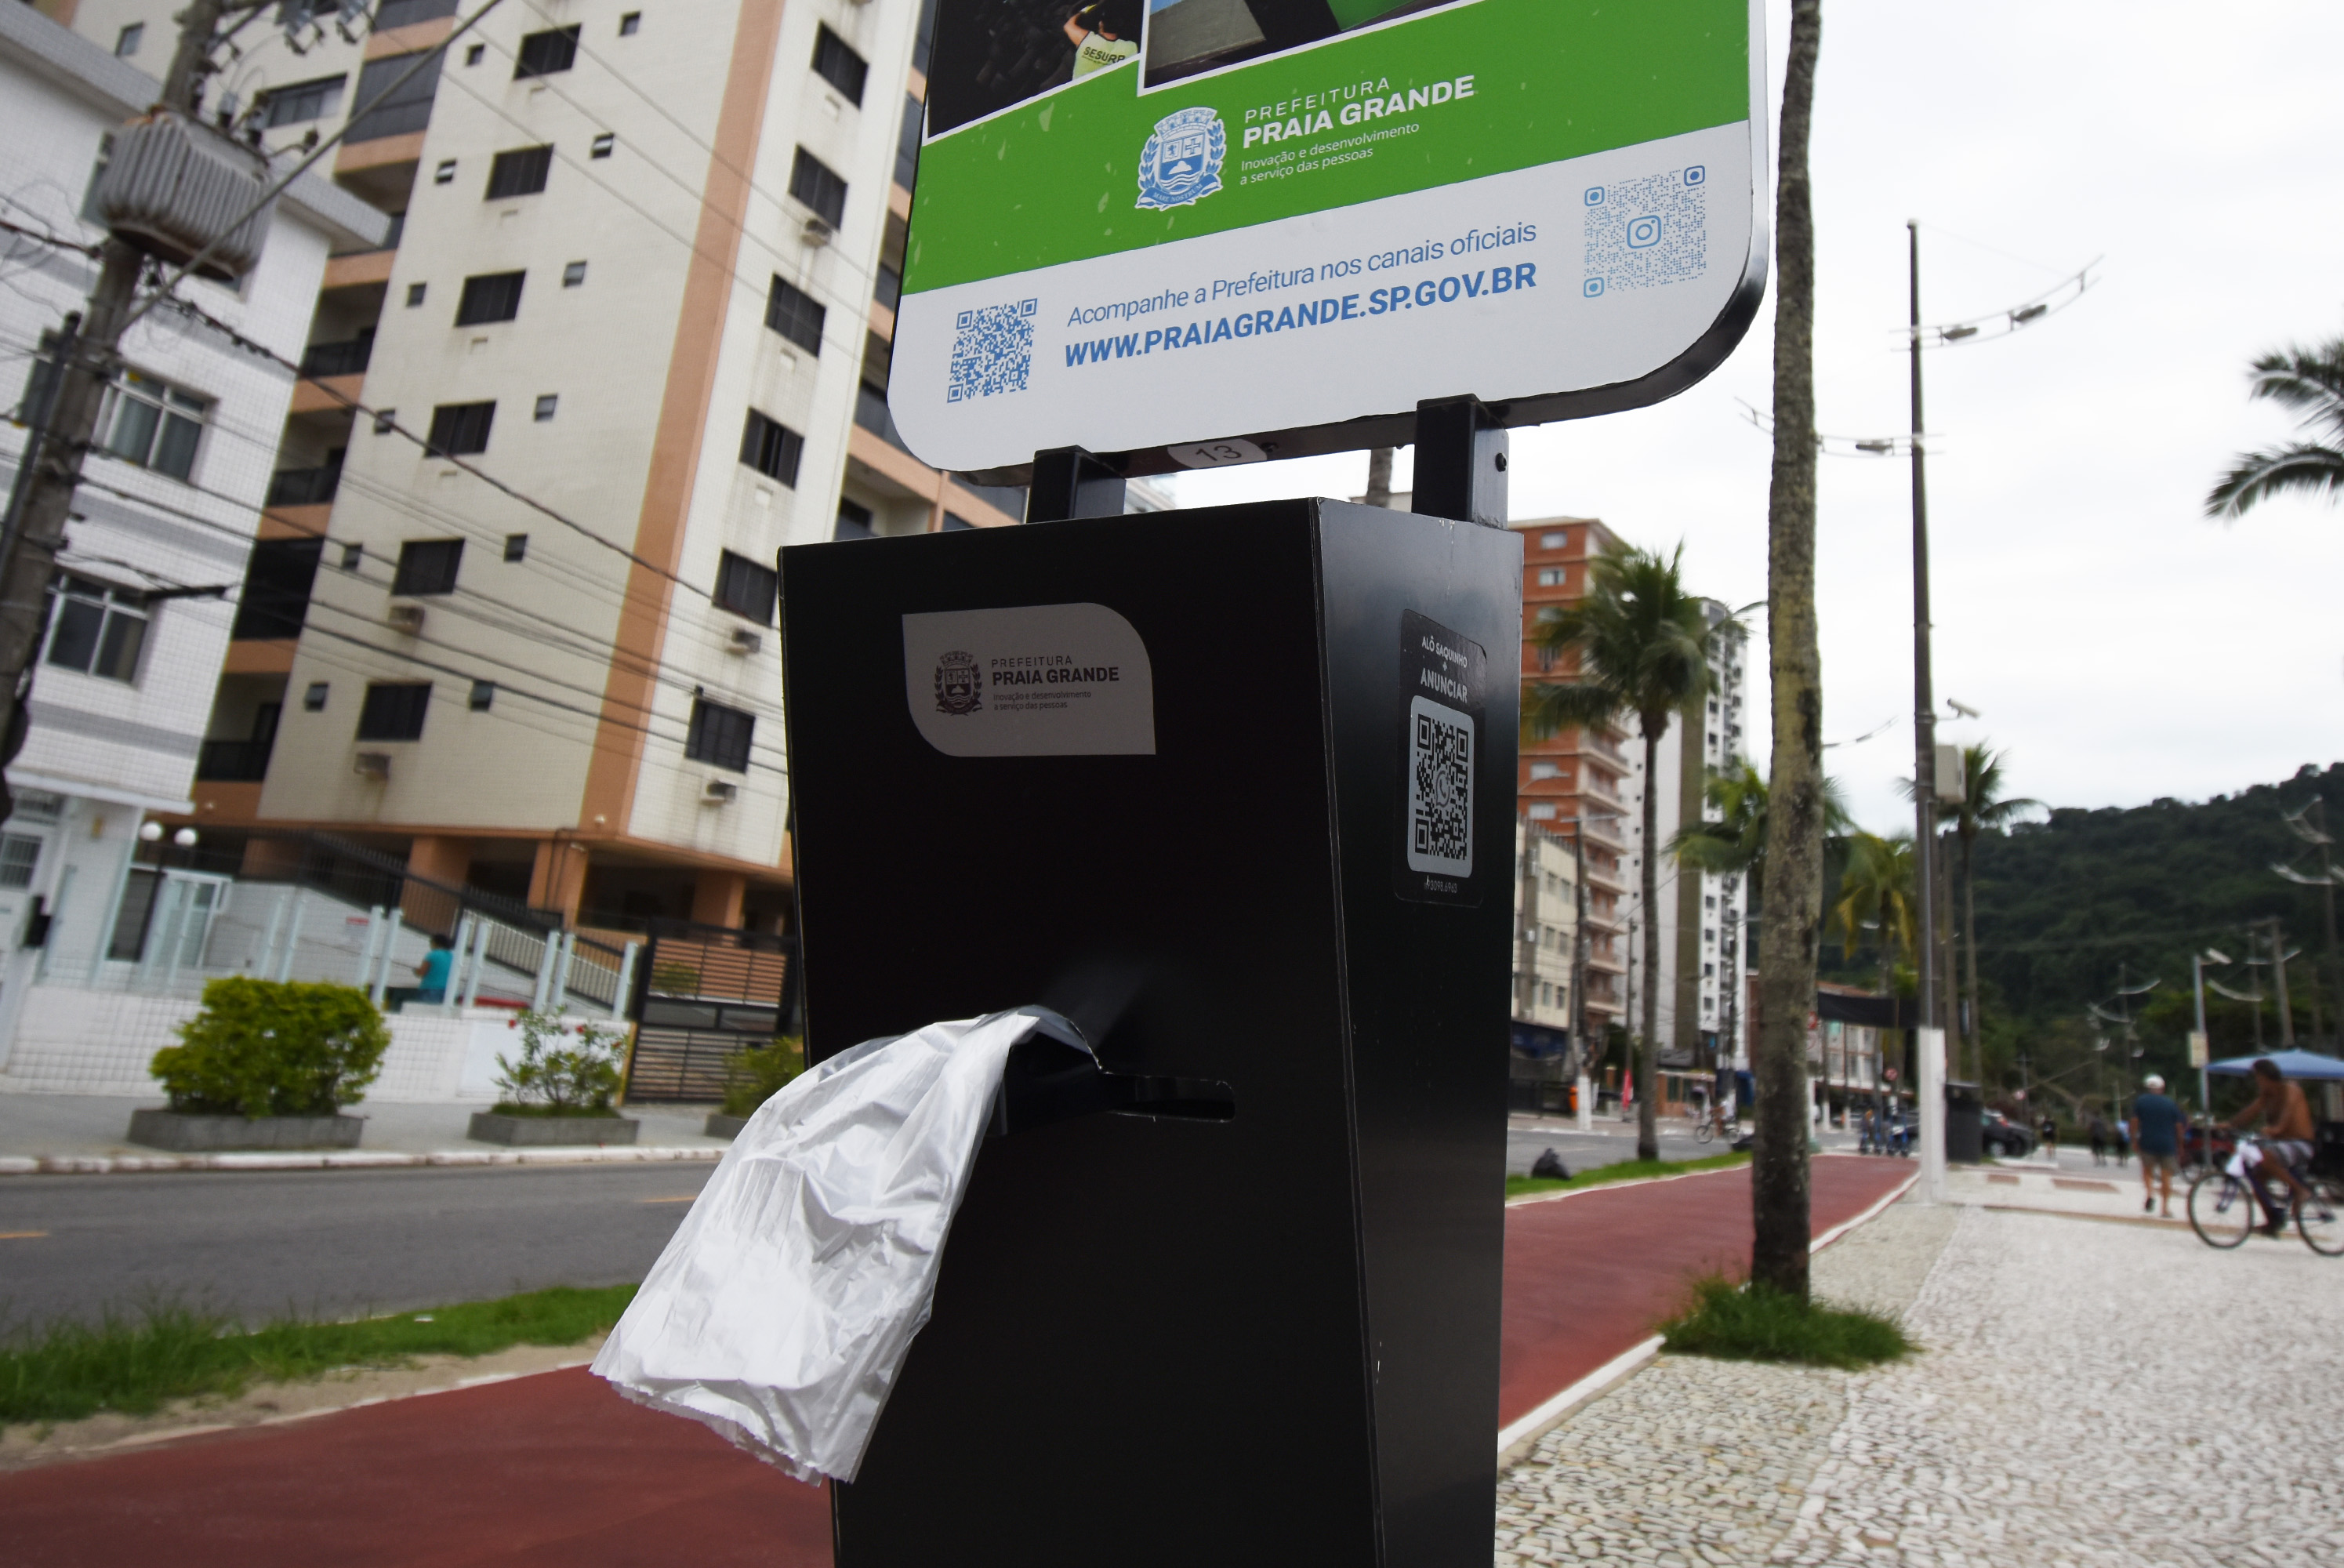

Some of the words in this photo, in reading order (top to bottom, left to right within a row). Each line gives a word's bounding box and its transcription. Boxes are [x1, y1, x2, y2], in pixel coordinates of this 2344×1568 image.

[1243, 110, 1334, 149] PRAIA
[1339, 74, 1475, 125] GRANDE
[1245, 78, 1390, 123] PREFEITURA
[1241, 151, 1295, 171] Inovação
[1299, 148, 1307, 158] e
[1309, 123, 1420, 156] desenvolvimento
[1240, 176, 1247, 185] a
[1250, 165, 1294, 183] serviço
[1297, 159, 1319, 173] das
[1322, 147, 1373, 170] pessoas
[1067, 289, 1188, 327] Acompanhe
[1195, 288, 1206, 303] a
[1212, 267, 1315, 300] Prefeitura
[1320, 258, 1362, 281] nos
[1367, 239, 1444, 271] canais
[1450, 222, 1537, 256] oficiais
[1065, 263, 1537, 367] WWW.PRAIAGRANDE.SP.GOV.BR
[1196, 445, 1242, 461] 13
[992, 655, 1072, 668] PREFEITURA
[1421, 635, 1435, 652] ALÔ
[1435, 643, 1468, 668] SAQUINHO
[992, 669, 1043, 686] PRAIA
[1046, 666, 1119, 684] GRANDE
[1421, 668, 1468, 703] ANUNCIAR
[993, 692, 1024, 702] Inovação
[1032, 691, 1091, 700] desenvolvimento
[1000, 702, 1024, 711] serviço
[1039, 702, 1068, 711] pessoas
